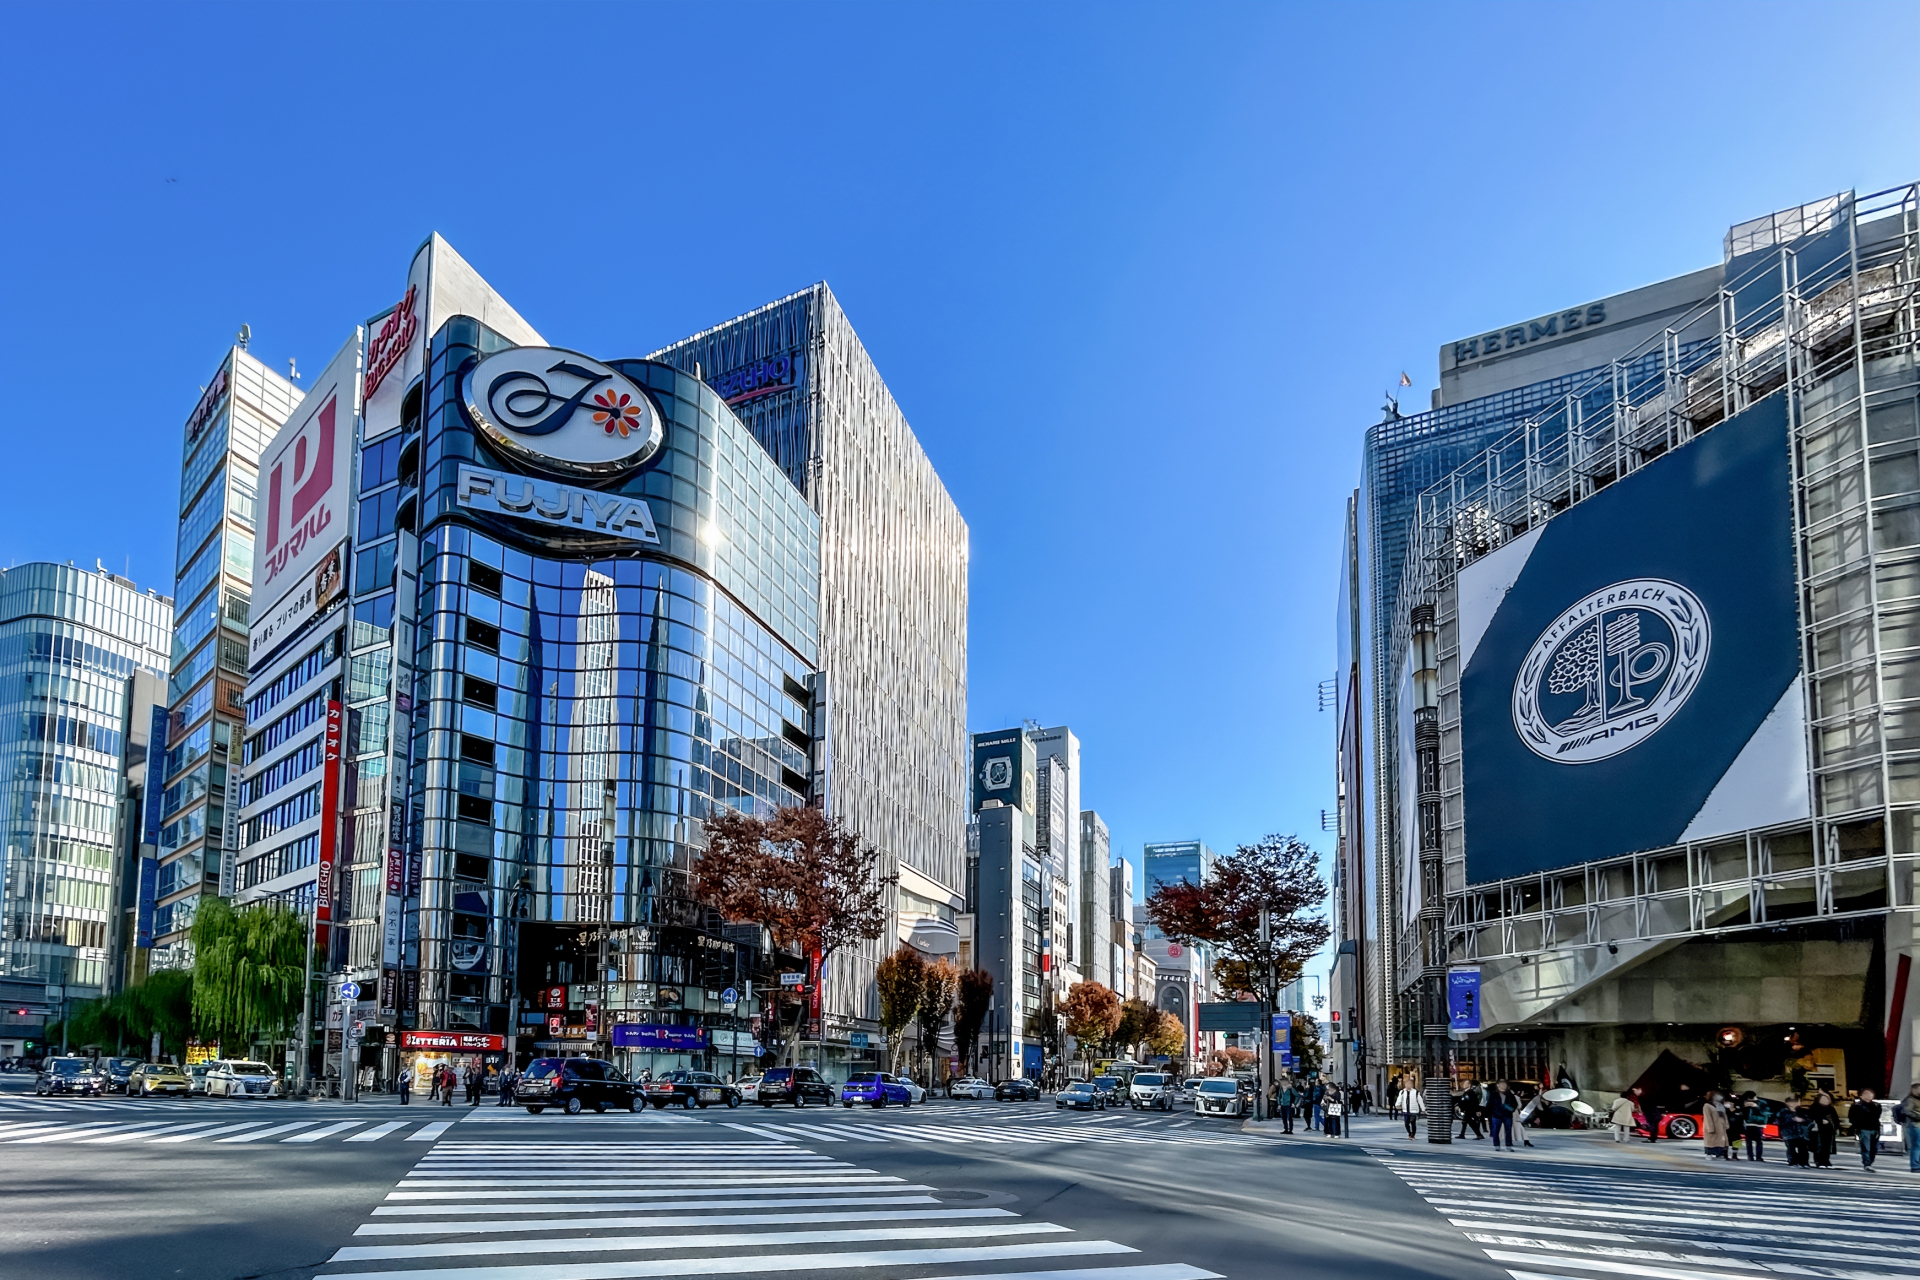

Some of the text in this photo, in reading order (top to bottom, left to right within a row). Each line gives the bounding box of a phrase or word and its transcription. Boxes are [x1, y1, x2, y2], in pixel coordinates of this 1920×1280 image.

[367, 284, 416, 370] カラオケ
[1458, 303, 1606, 362] HERMES
[712, 356, 789, 398] IZUHO
[459, 470, 656, 538] FUJIYA
[265, 503, 331, 586] プリマハム
[1542, 587, 1666, 649] AFFALTERBACH
[327, 709, 339, 761] カラオケ
[977, 740, 1001, 748] RICHARD
[1588, 712, 1658, 745] AMG
[318, 861, 331, 908] BIG ECHO
[387, 919, 397, 946] 不二家
[411, 1035, 458, 1046] ZETTERIA
[699, 1091, 721, 1100] S.RIDE
